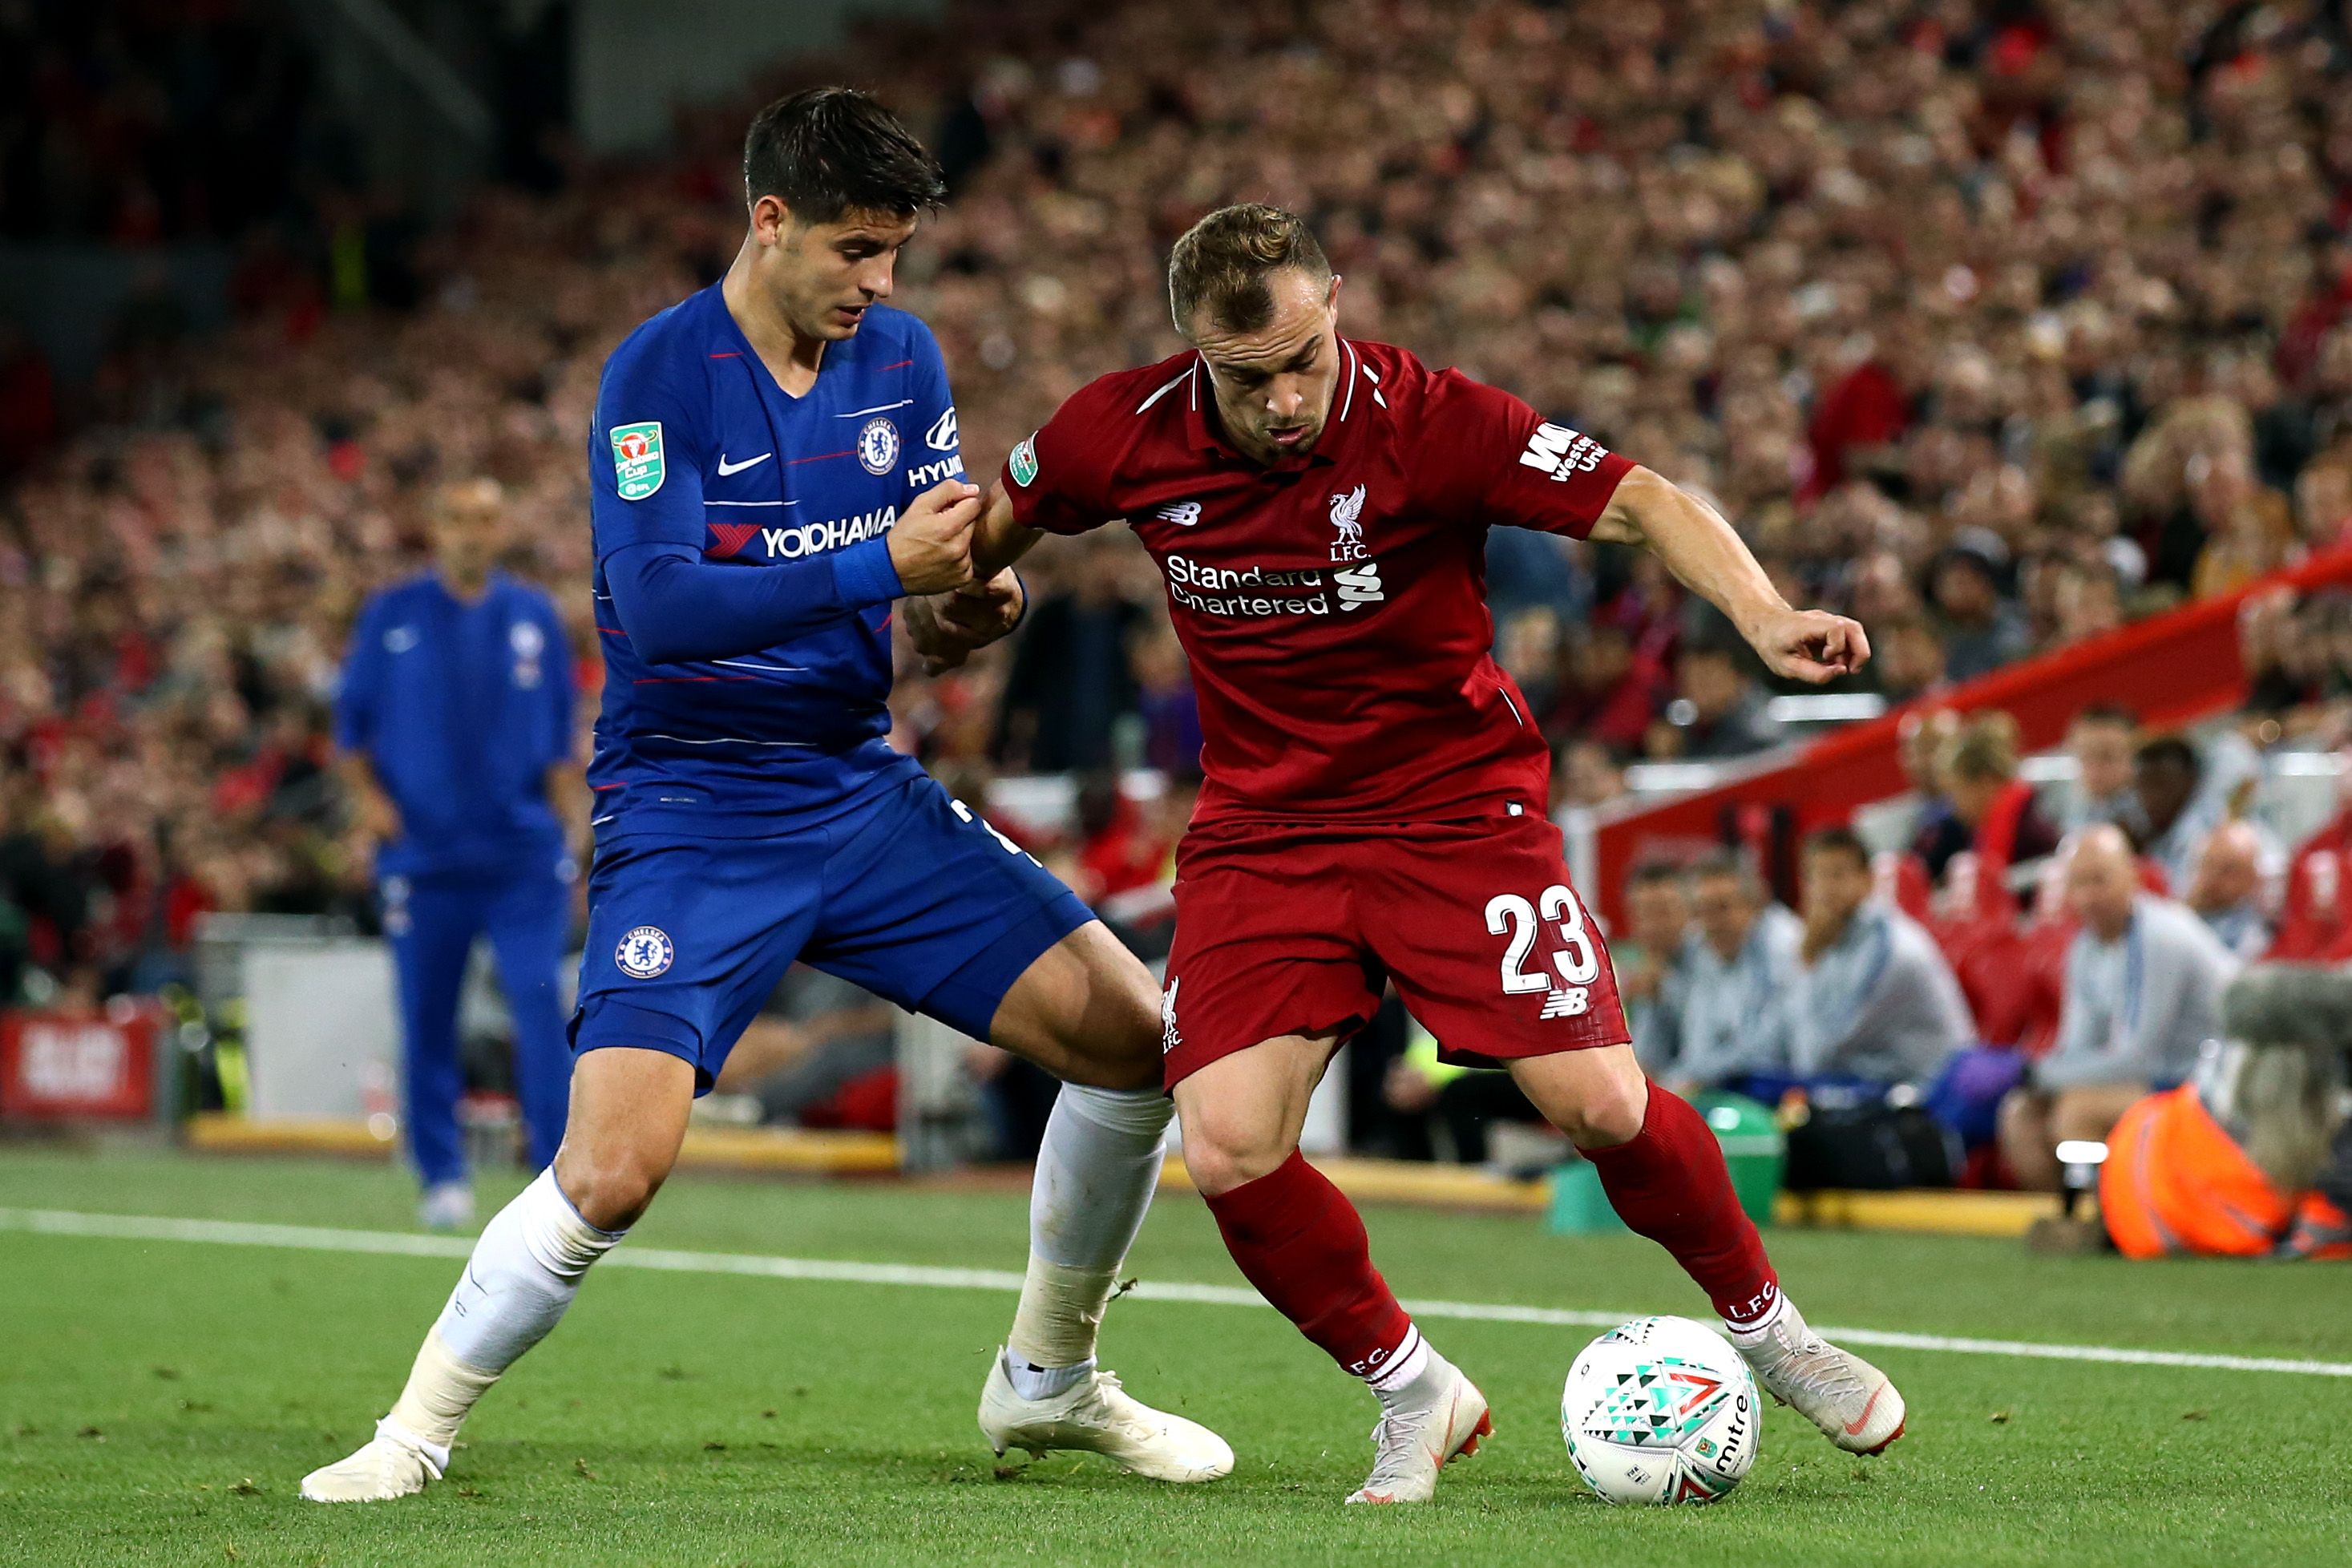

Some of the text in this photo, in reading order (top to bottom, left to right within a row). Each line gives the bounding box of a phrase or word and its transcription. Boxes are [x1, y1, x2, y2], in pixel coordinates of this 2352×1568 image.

[1550, 436, 1596, 482] Weste
[761, 505, 896, 558] YOKOHAMA
[1167, 555, 1322, 590] Standard
[1170, 581, 1329, 616] Chartered
[1485, 885, 1599, 995] 23
[1716, 1395, 1748, 1473] mitre
